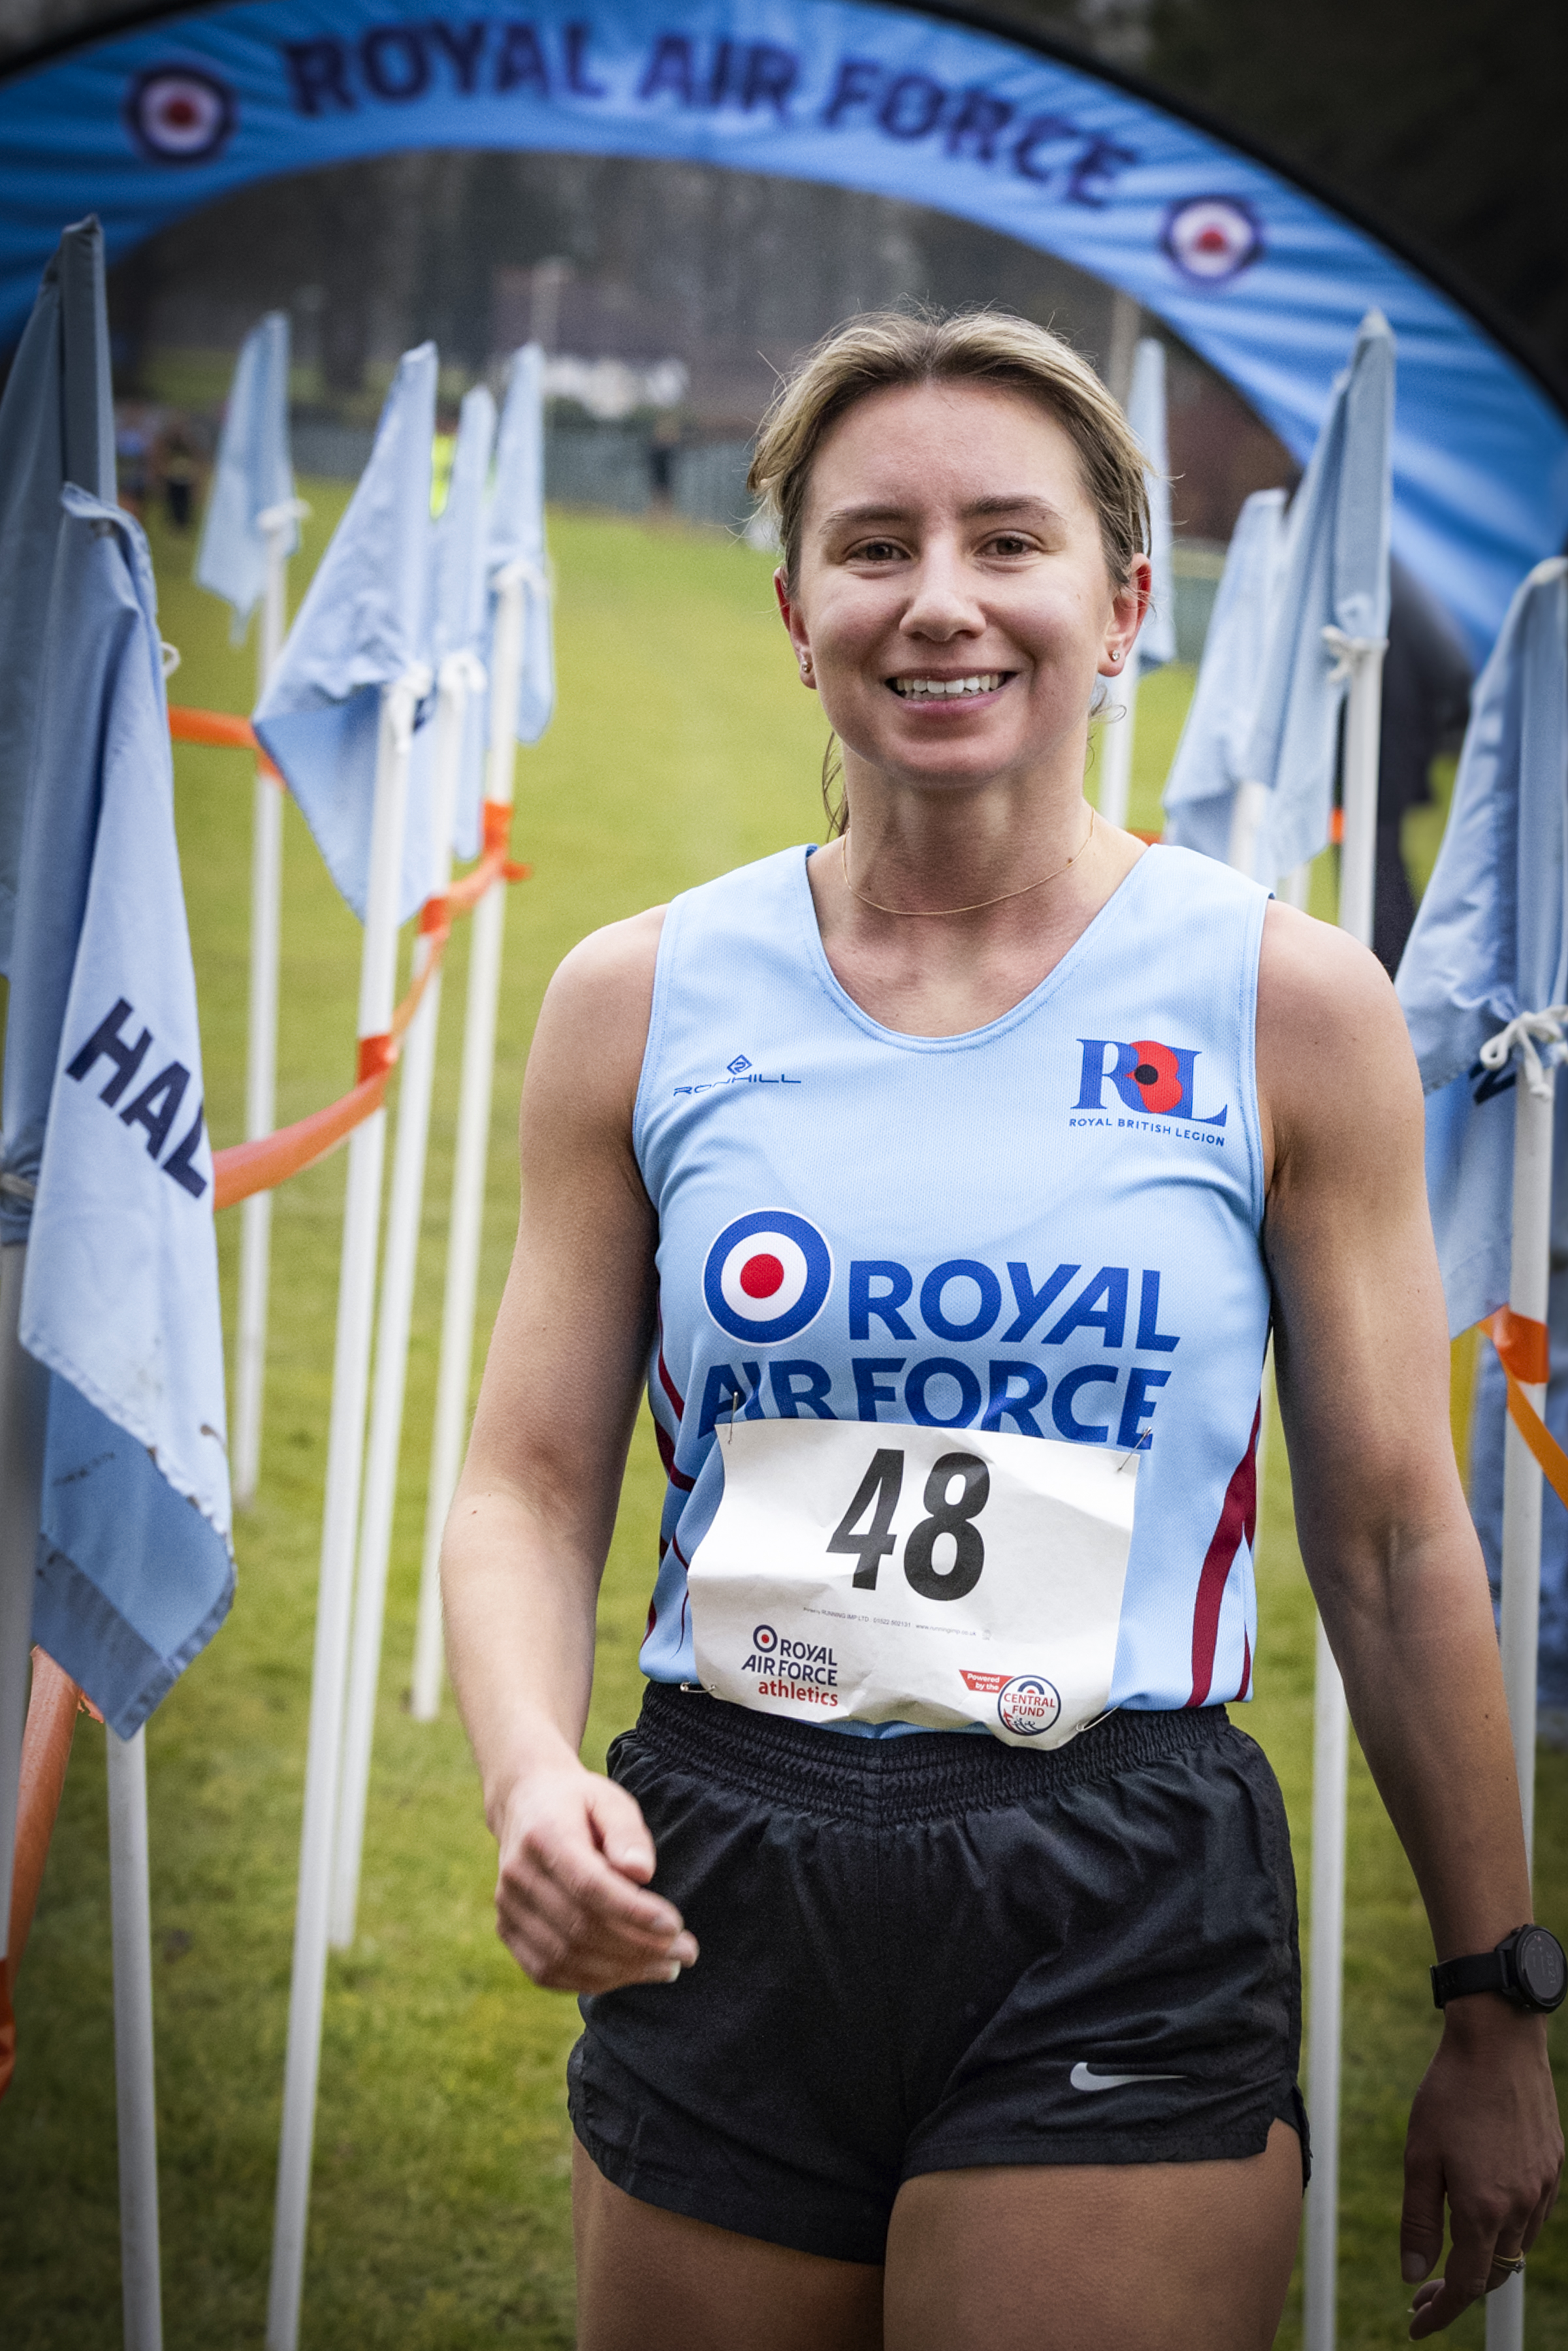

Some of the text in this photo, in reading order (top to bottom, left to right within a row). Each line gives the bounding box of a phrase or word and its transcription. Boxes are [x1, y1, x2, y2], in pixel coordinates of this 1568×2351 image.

[284, 18, 1143, 210] ROYAL AIR FORCE
[673, 1074, 801, 1096] RONHILL
[1069, 1118, 1225, 1146] ROYAL BRITISH LEGION
[850, 1259, 1181, 1352] ROYAL
[697, 1356, 1172, 1450] AIR FORCE
[827, 1448, 990, 1601] 48
[780, 1639, 837, 1666] ROYAL
[741, 1654, 838, 1687] AIR FORCE
[967, 1672, 1000, 1683] Powered
[758, 1679, 838, 1706] athletics
[1004, 1693, 1055, 1708] CENTRAL
[1012, 1705, 1045, 1717] FUND
